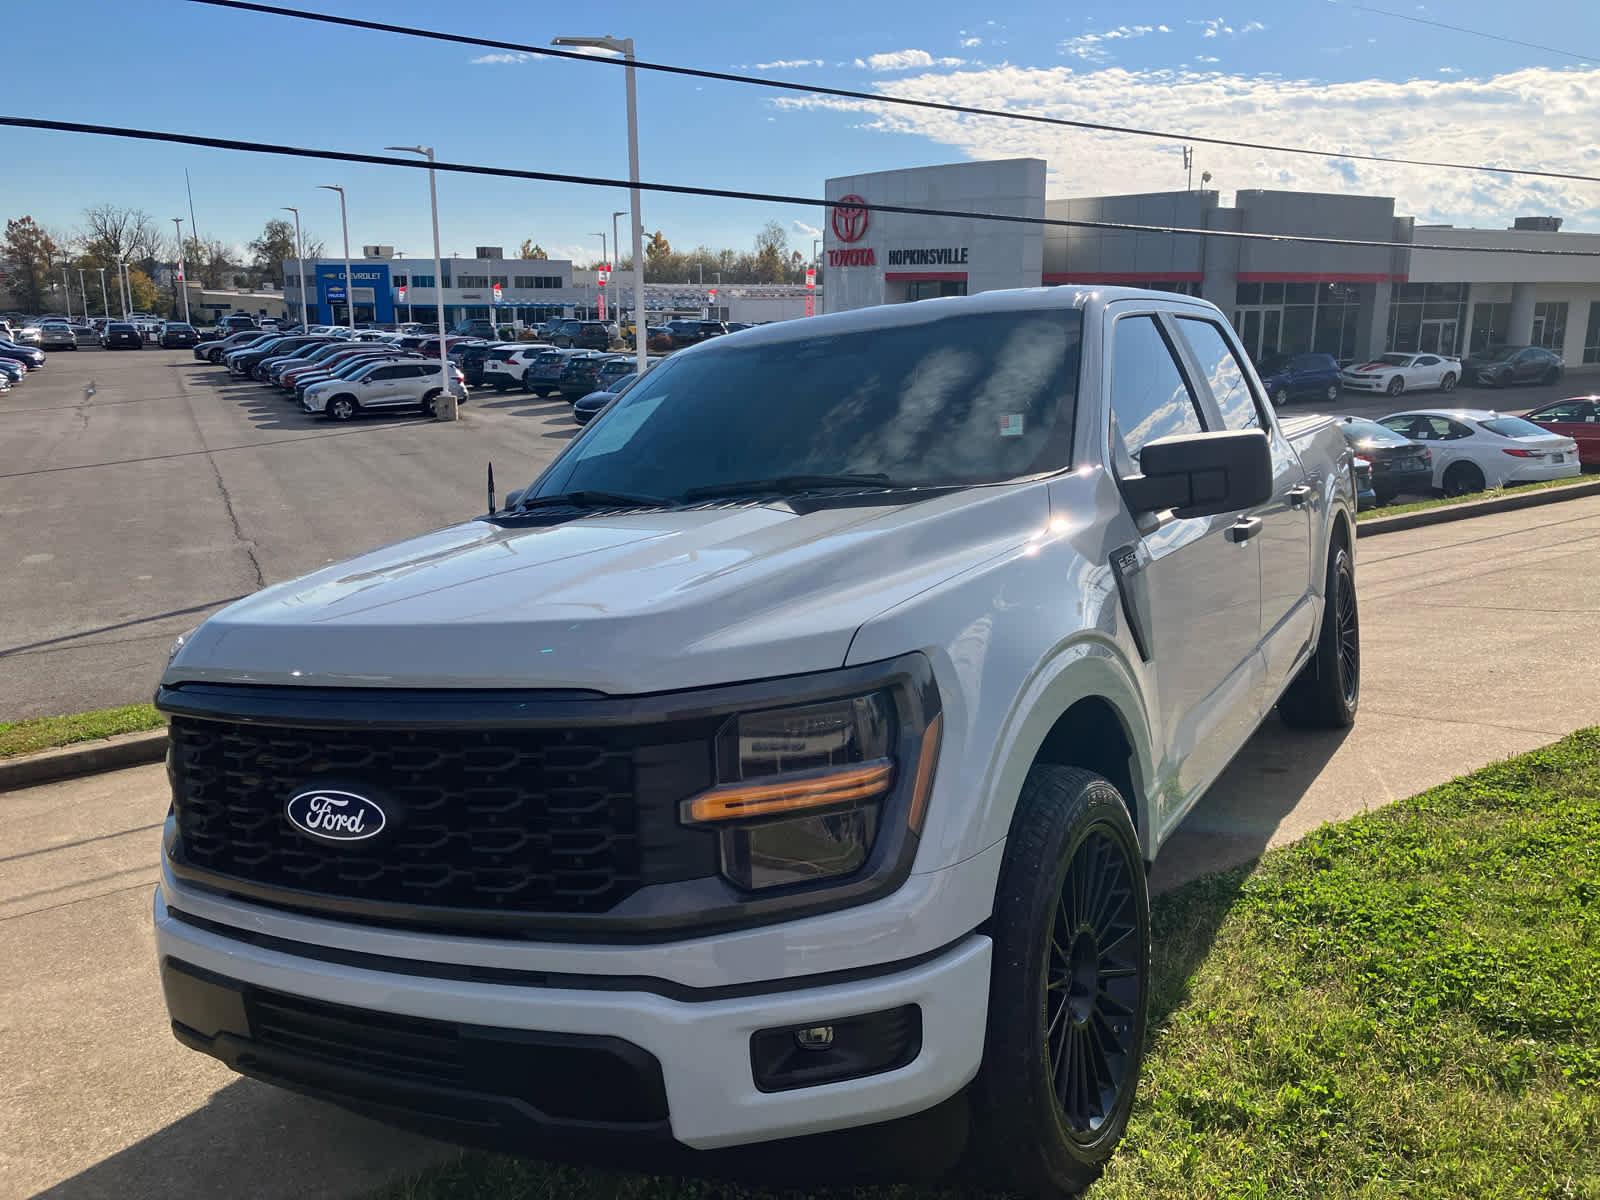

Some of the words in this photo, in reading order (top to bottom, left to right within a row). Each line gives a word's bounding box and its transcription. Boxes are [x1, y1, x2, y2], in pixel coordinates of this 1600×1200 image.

[827, 247, 875, 267] TOYOTA
[888, 247, 969, 266] HOPKINSVILLE
[306, 796, 365, 833] Ford
